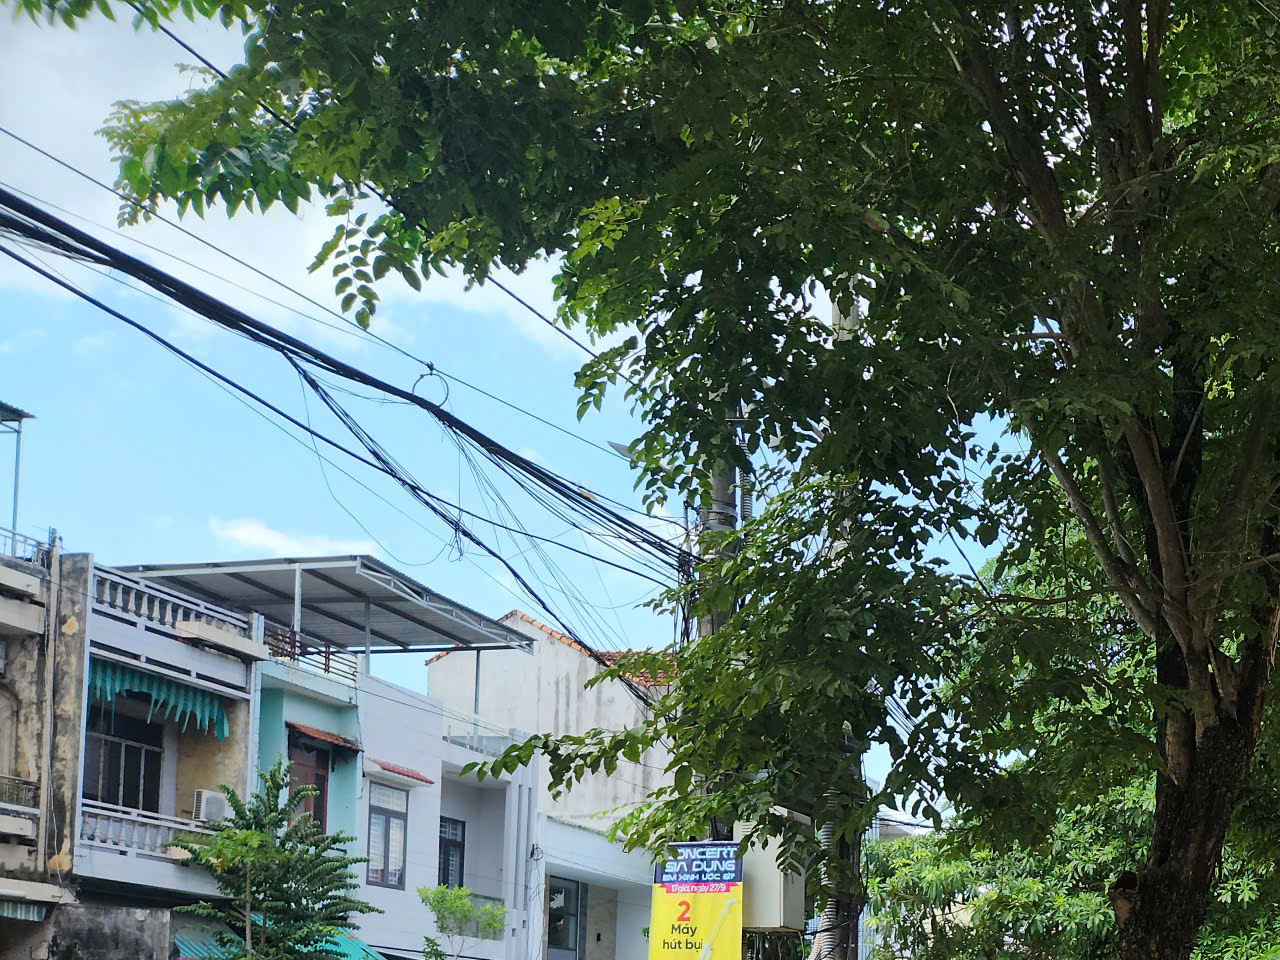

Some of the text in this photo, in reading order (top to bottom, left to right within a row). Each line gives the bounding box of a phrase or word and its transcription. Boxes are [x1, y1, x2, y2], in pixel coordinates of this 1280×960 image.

[667, 847, 738, 860] ONCERT
[691, 860, 736, 873] DỤNG
[677, 900, 691, 922] 2
[671, 923, 698, 938] Máy
[663, 938, 703, 953] hút bụi
